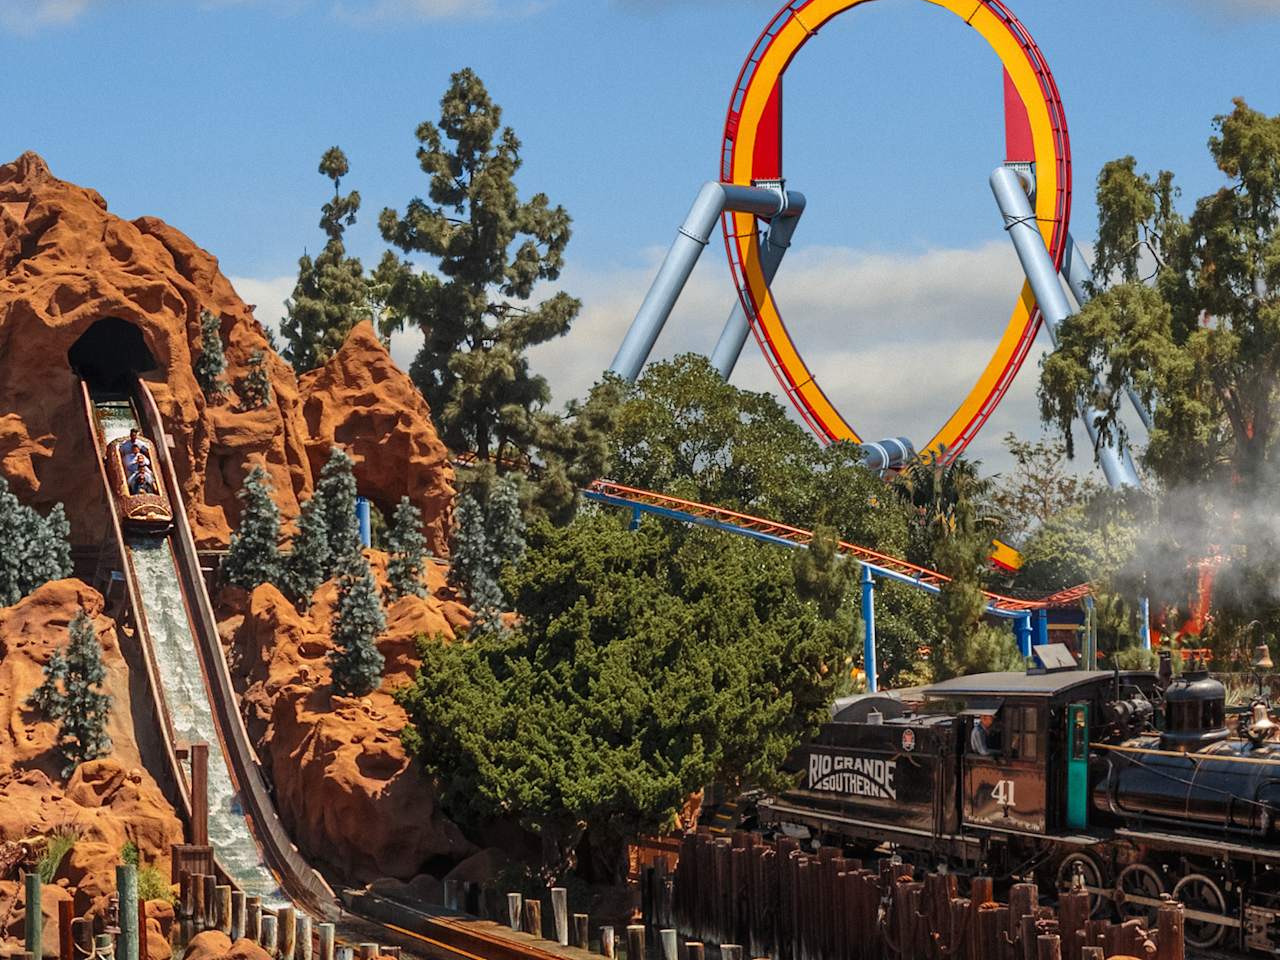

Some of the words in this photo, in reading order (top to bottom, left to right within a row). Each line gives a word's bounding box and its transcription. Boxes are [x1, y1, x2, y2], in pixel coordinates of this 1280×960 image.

[809, 754, 832, 789] RIO
[834, 756, 896, 800] GRANDE
[822, 773, 879, 797] SOUTHERN
[991, 780, 1016, 806] 41
